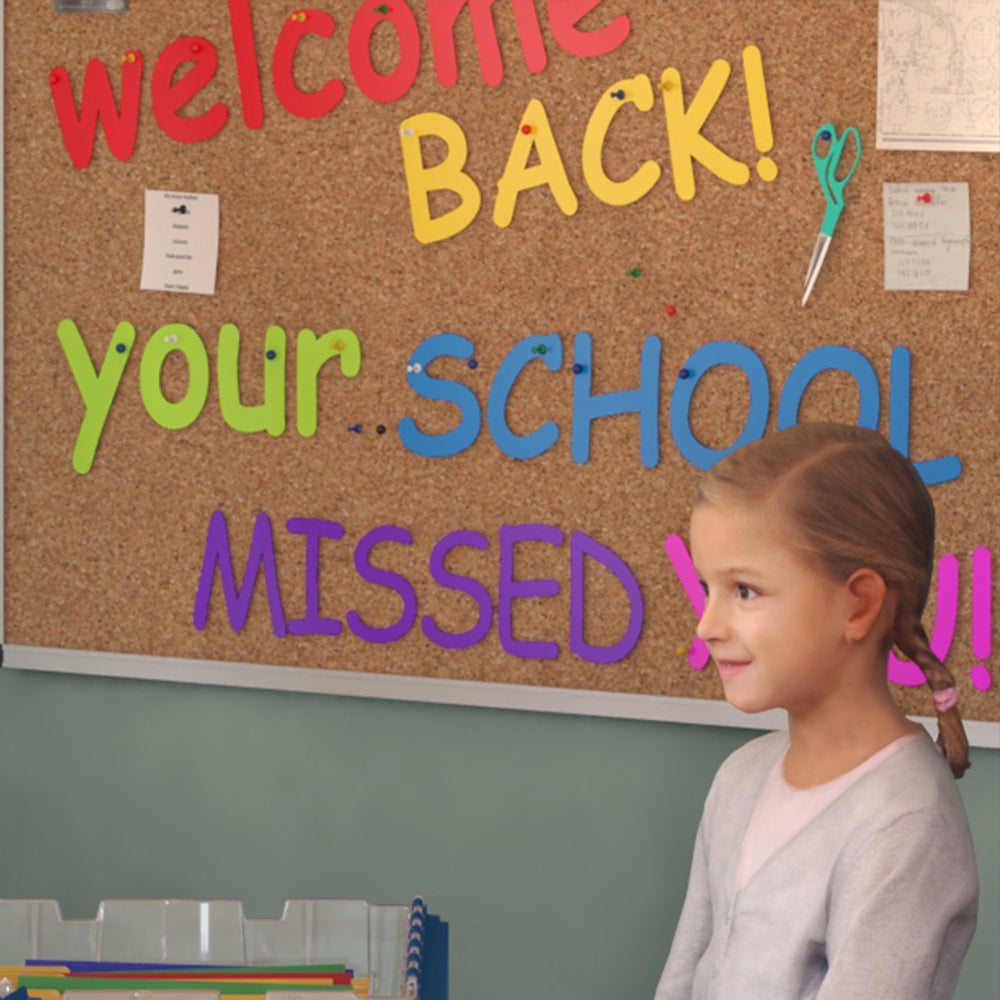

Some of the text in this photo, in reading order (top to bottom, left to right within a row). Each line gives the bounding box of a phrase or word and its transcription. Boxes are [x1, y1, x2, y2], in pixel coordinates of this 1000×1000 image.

[50, 0, 631, 168] welcome
[400, 45, 778, 244] BACK!
[57, 318, 962, 484] your SCHOOL
[193, 510, 993, 691] MISSED YU!
